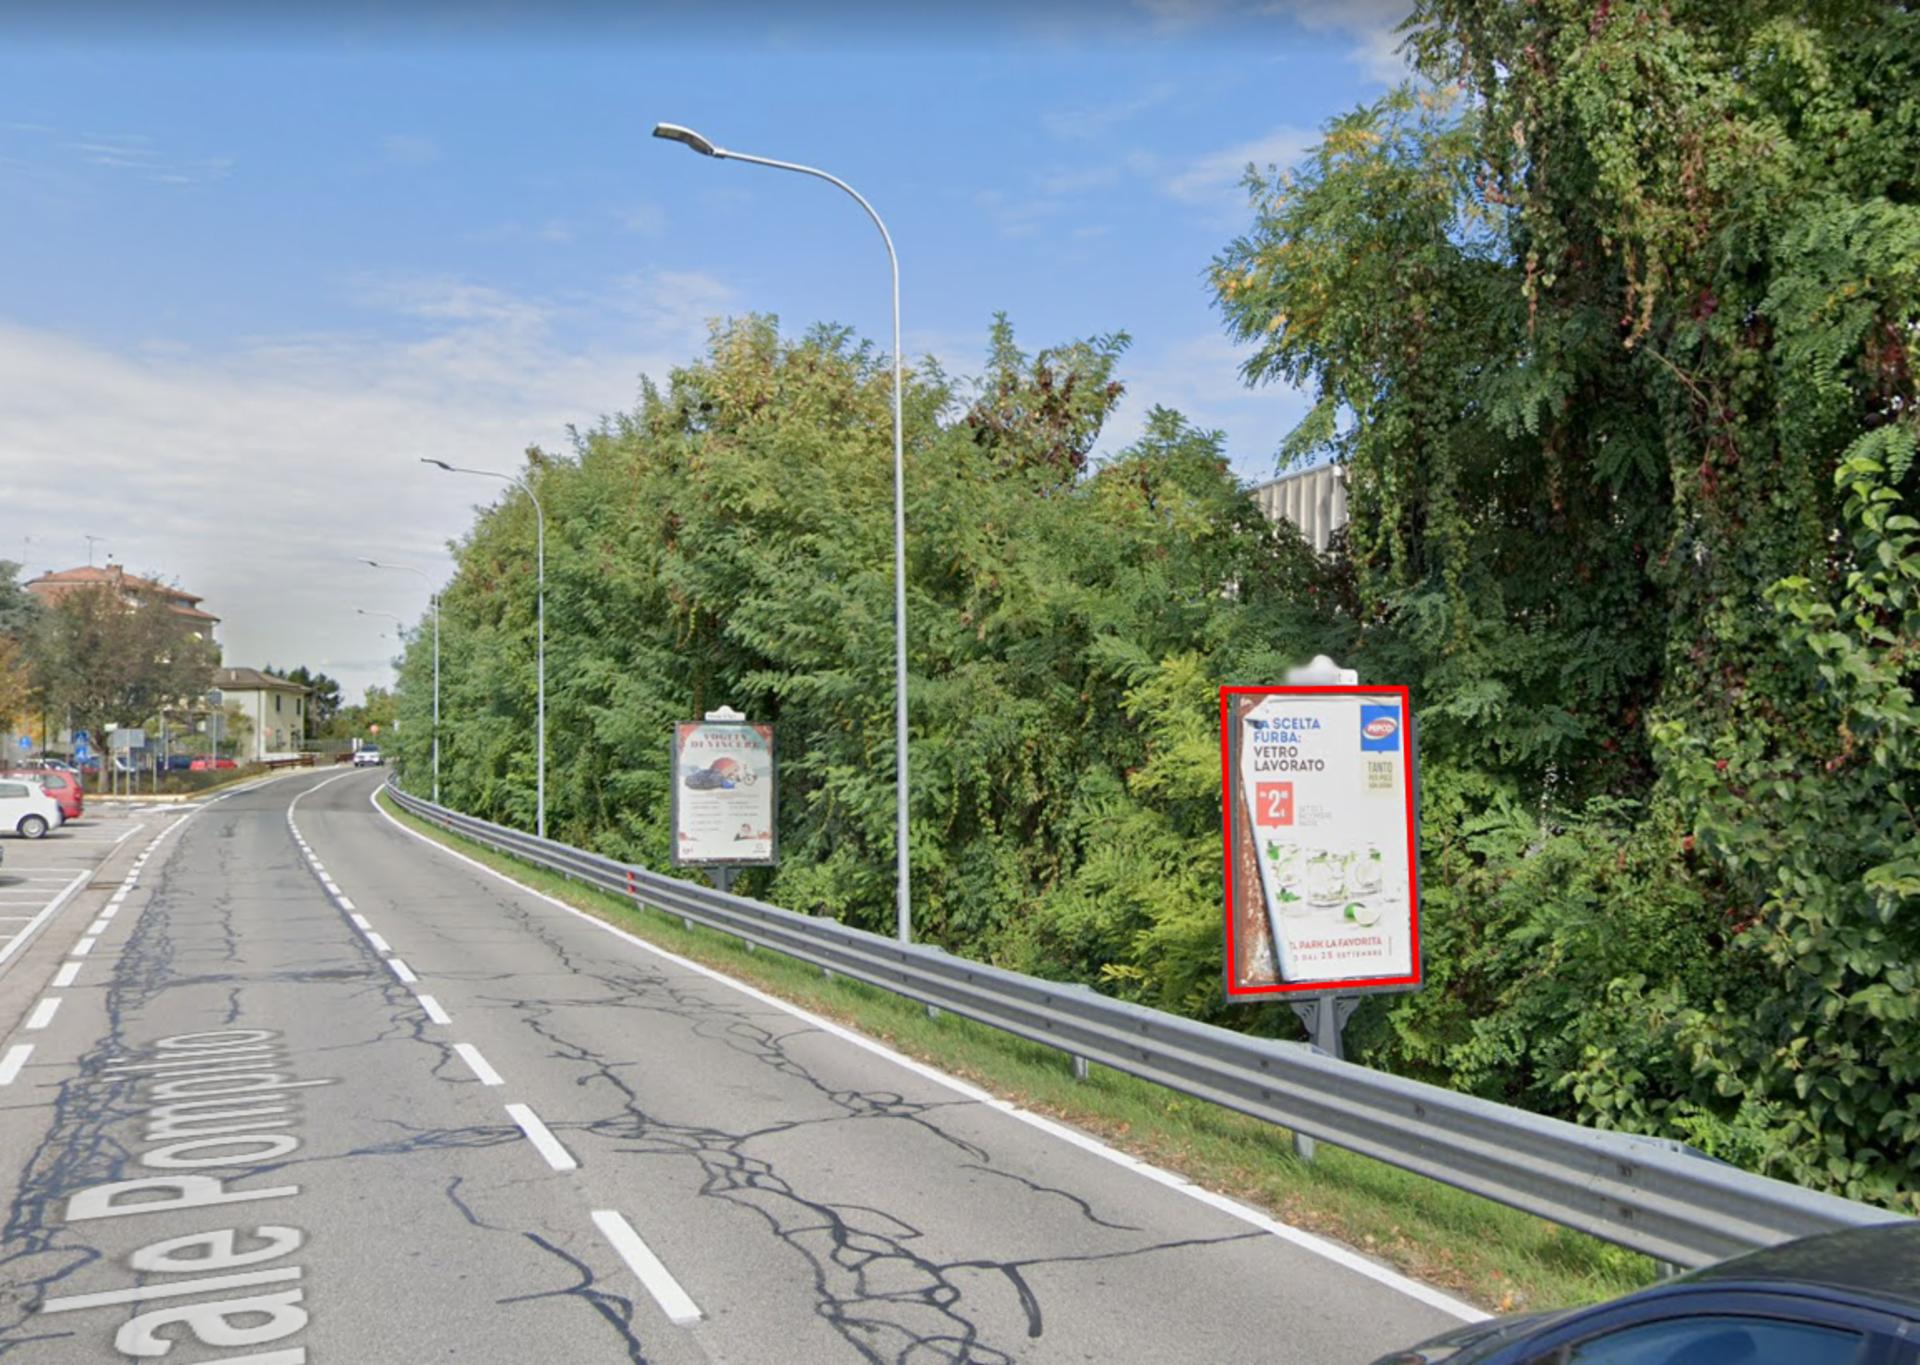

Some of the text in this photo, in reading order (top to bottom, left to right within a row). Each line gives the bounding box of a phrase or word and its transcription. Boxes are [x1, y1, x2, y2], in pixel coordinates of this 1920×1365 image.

[1273, 717, 1320, 729] SCELTA
[1254, 731, 1301, 743] FURBA:
[1254, 746, 1298, 758] VETRO
[1254, 759, 1325, 771] LAVORATO
[1368, 761, 1393, 772] TANTO
[1300, 940, 1323, 950] PARK
[1326, 939, 1336, 948] LA
[1339, 937, 1382, 948] FAVORITA
